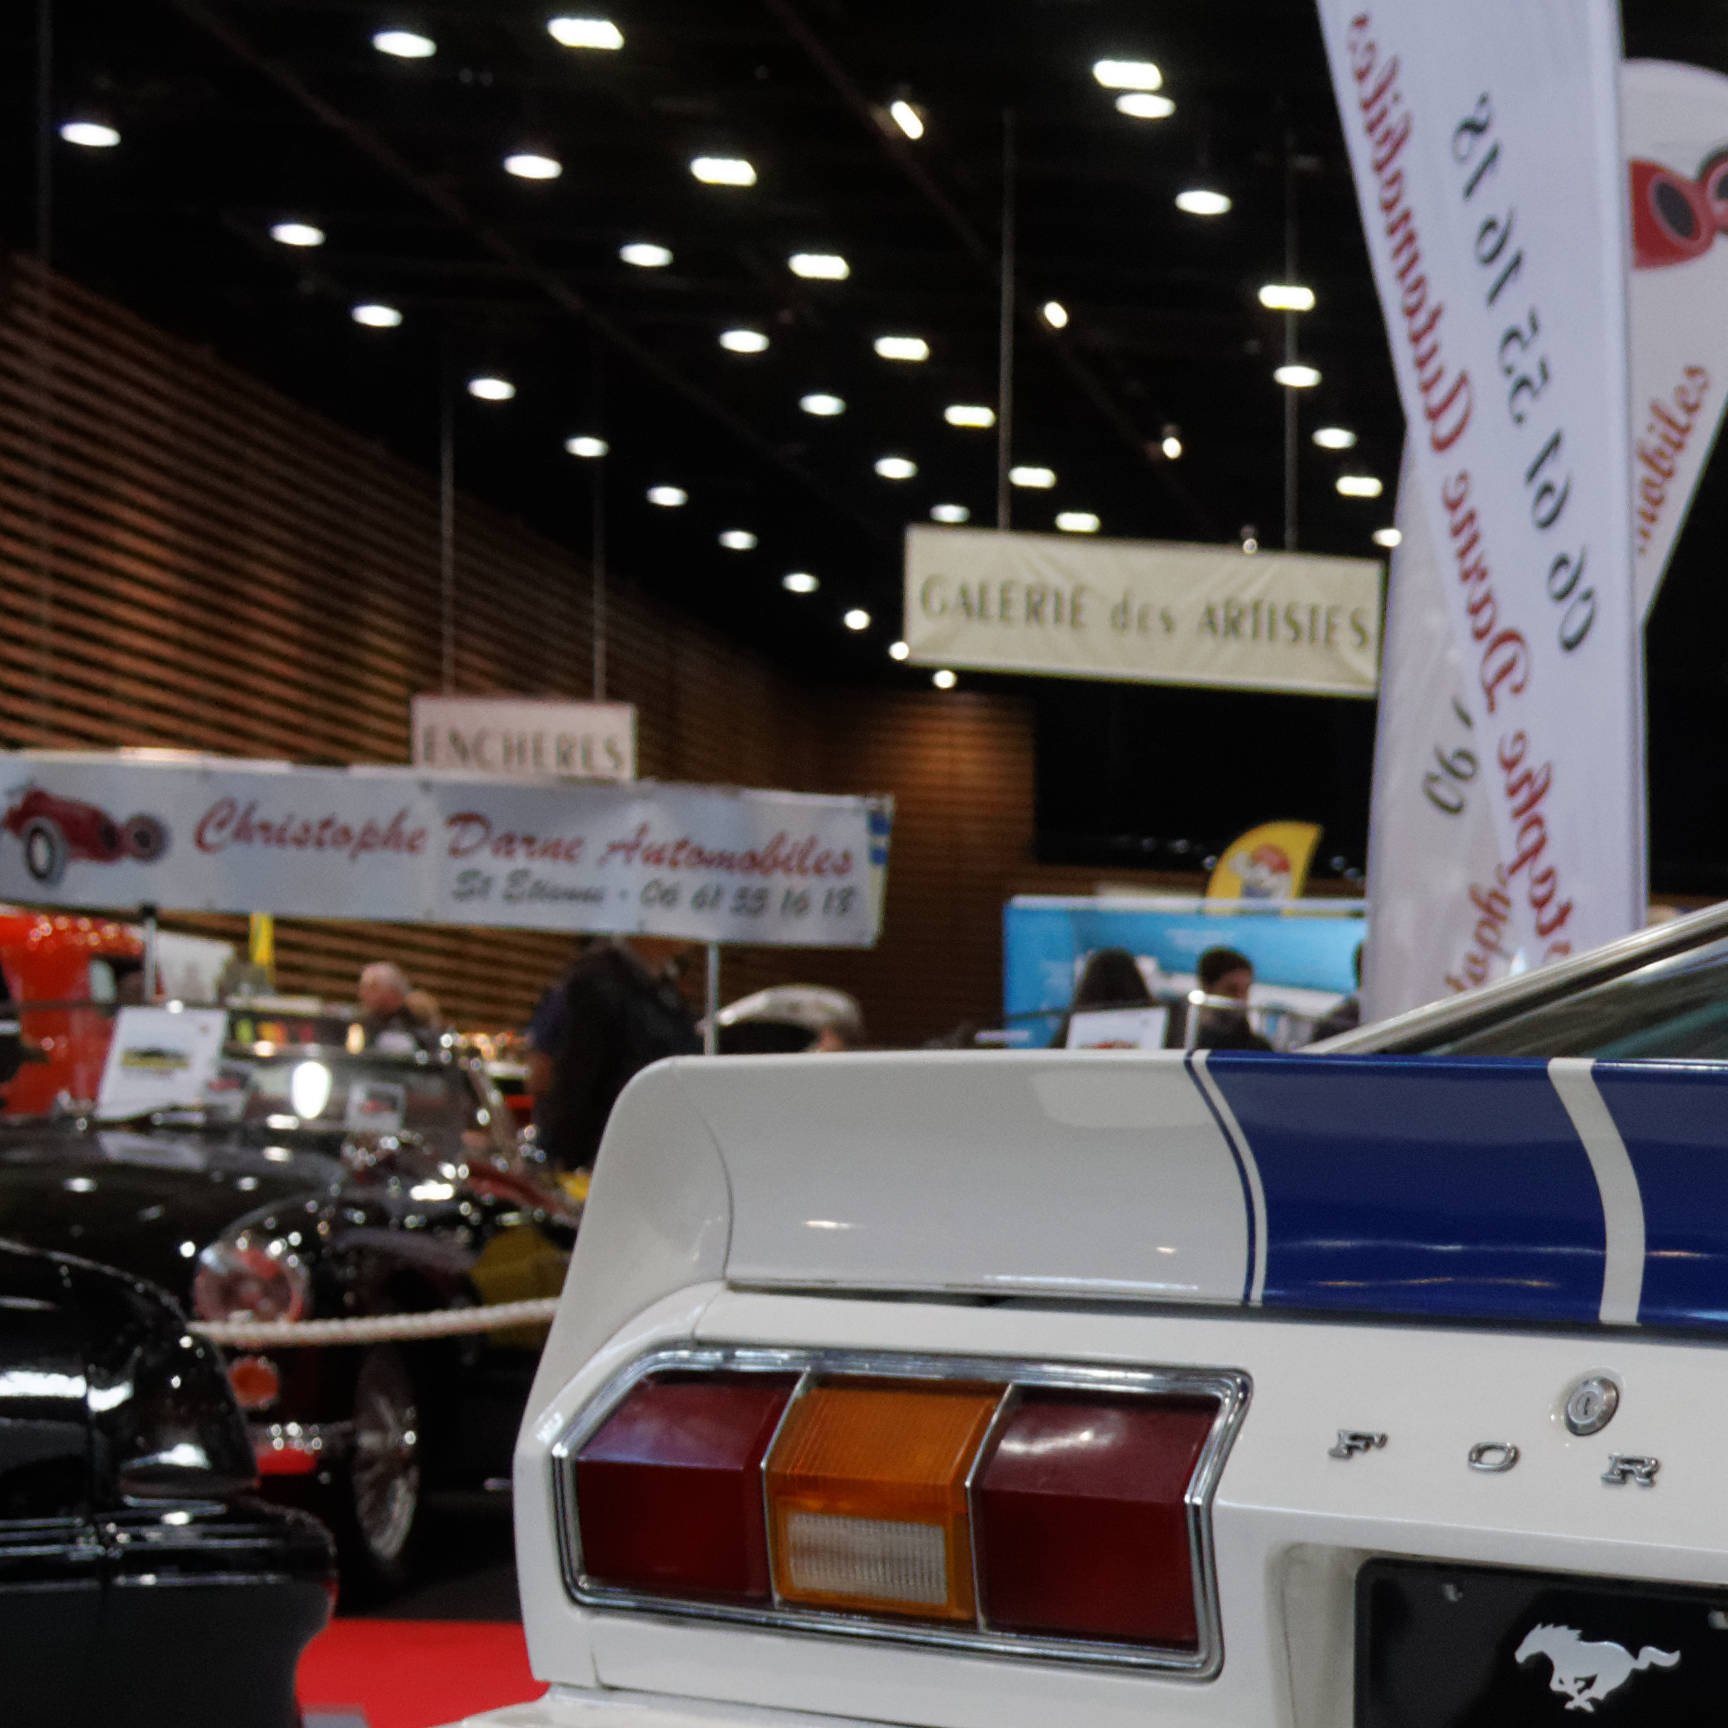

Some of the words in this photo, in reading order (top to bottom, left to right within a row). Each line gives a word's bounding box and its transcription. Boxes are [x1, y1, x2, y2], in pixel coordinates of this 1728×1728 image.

[919, 573, 1087, 631] GALERIE
[1109, 593, 1175, 635] des
[1198, 598, 1370, 650] ARTISTES
[1421, 744, 1481, 816] 06
[194, 797, 428, 861] Christophe
[444, 810, 585, 863] Darne
[597, 820, 854, 877] Automobiles
[641, 878, 681, 909] 06
